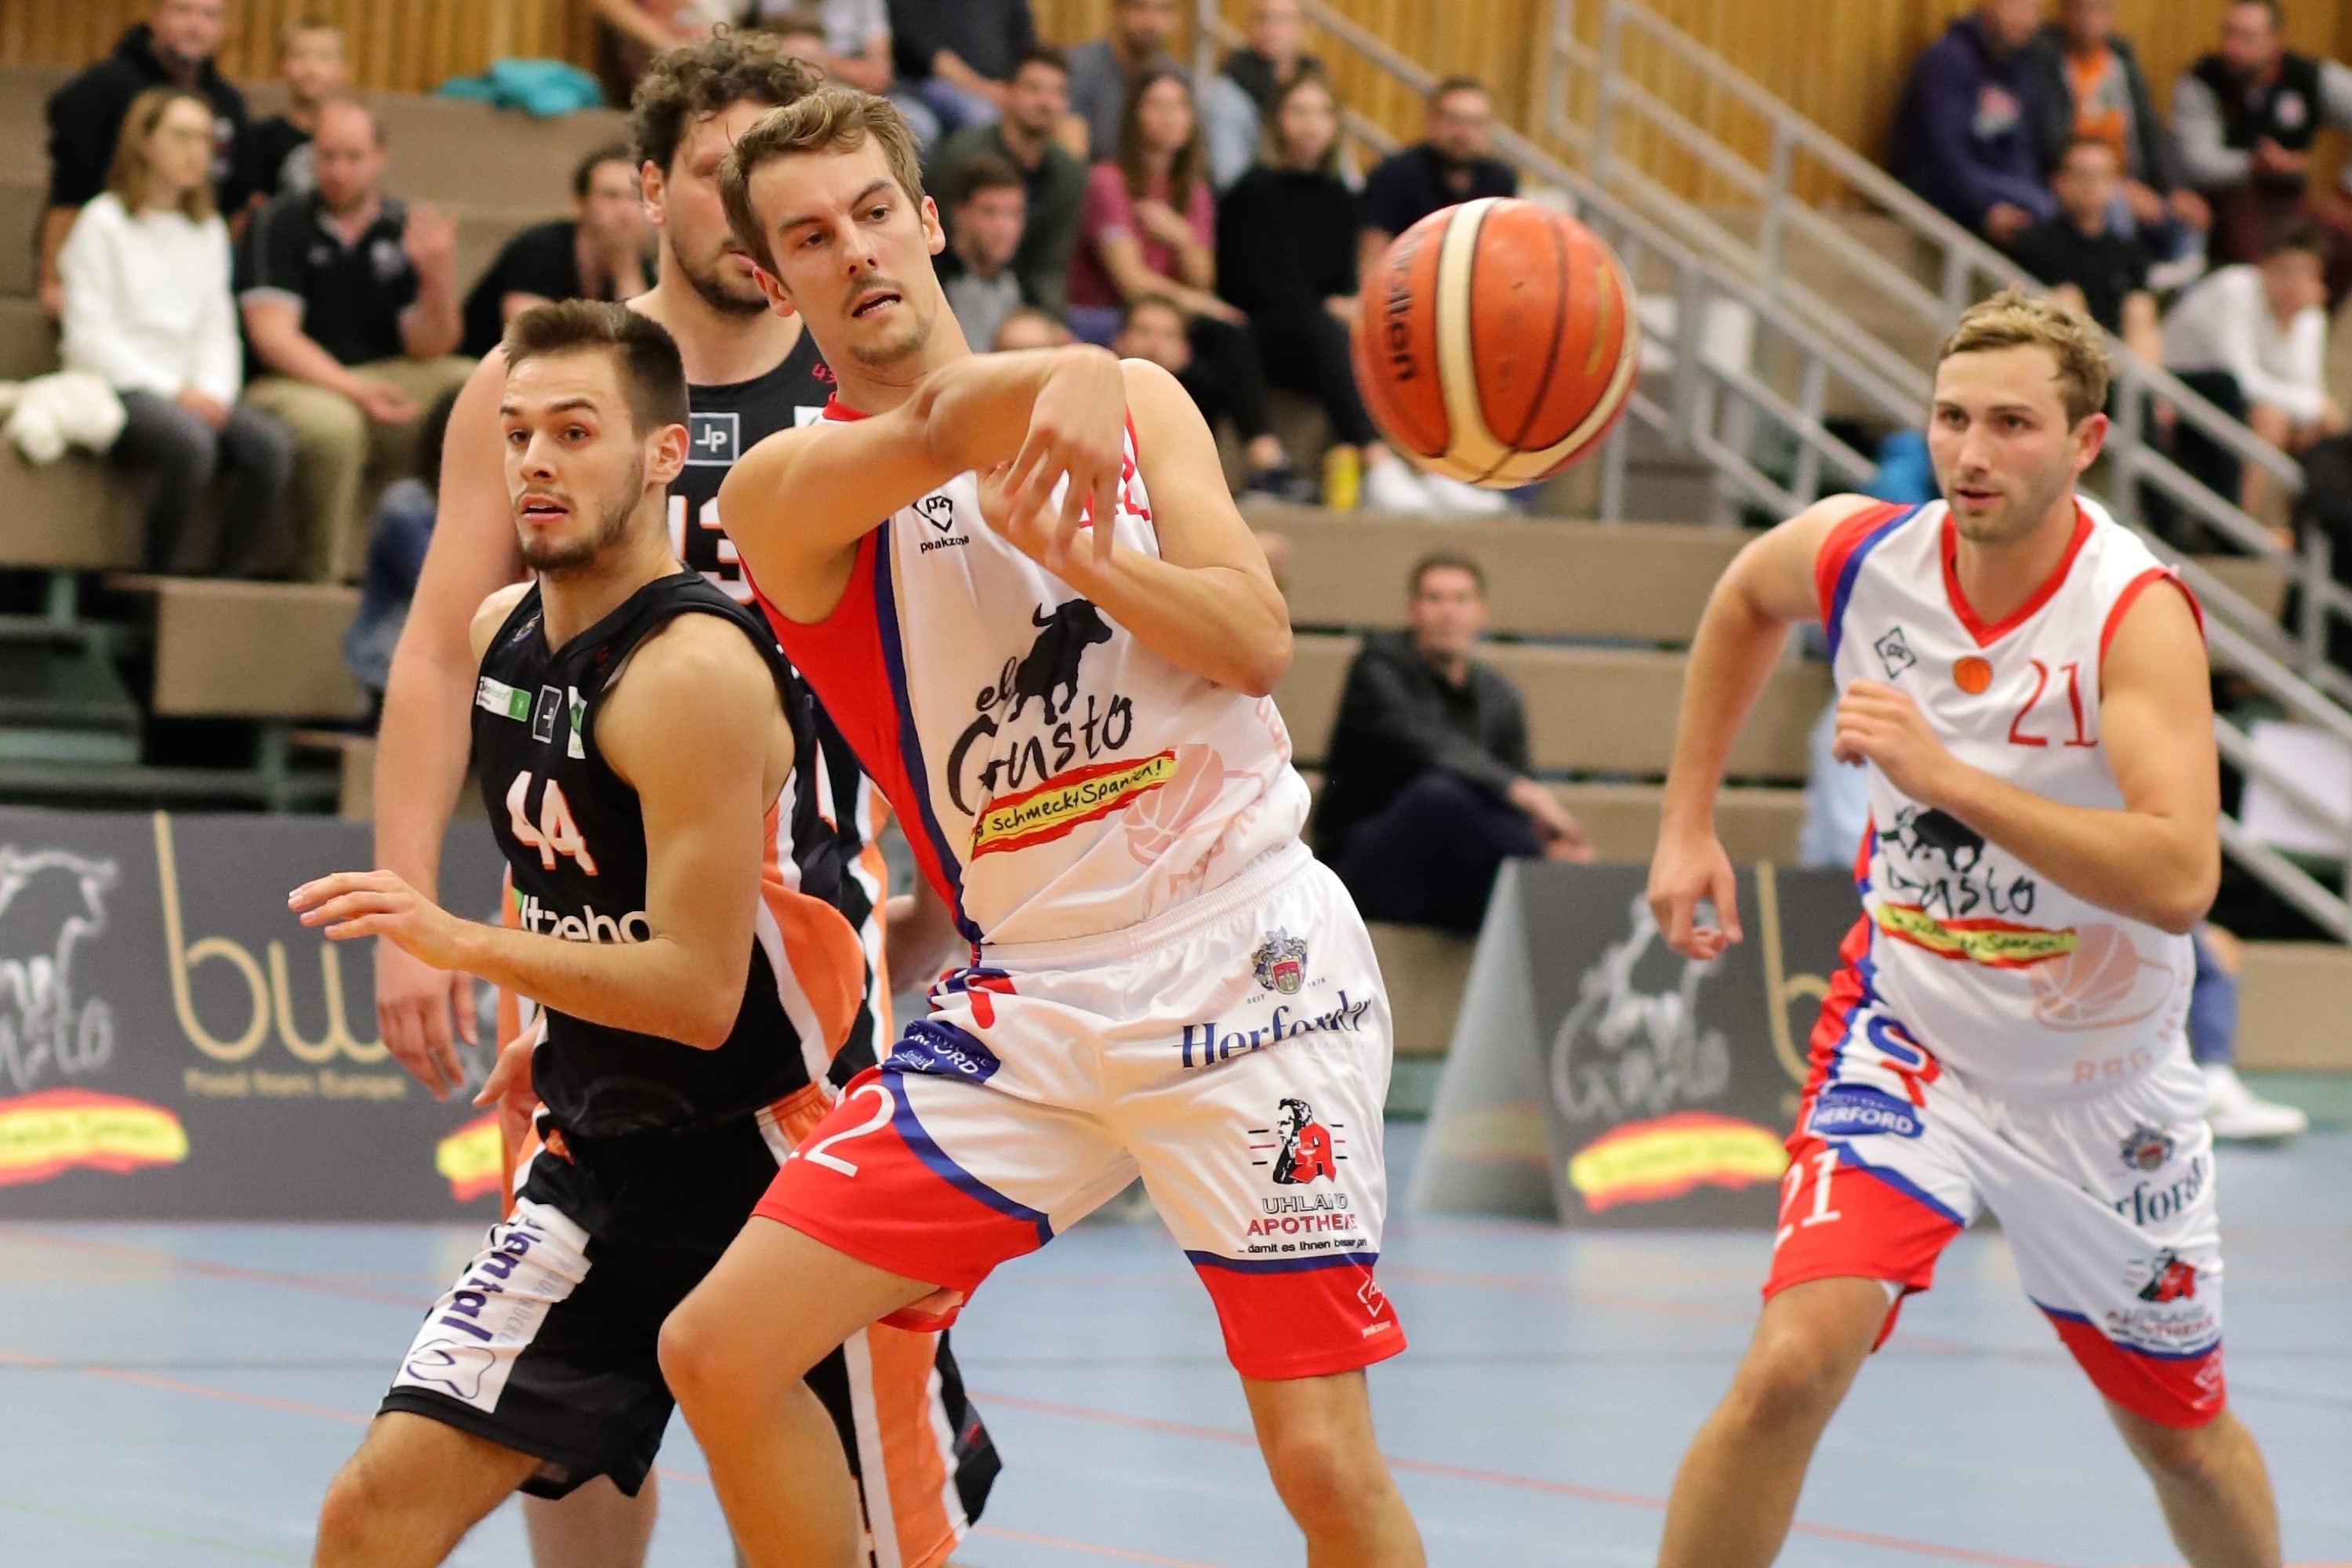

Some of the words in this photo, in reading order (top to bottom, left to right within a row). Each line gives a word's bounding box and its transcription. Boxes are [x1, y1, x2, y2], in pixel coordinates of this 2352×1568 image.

[695, 423, 728, 452] JP
[920, 535, 971, 554] peakzone
[976, 655, 1018, 712] el
[2008, 659, 2098, 747] 21
[947, 694, 1134, 818] Gusto
[506, 771, 598, 877] 44
[992, 789, 1080, 830] schmeckt
[1082, 759, 1163, 804] Spanien!
[788, 1083, 895, 1178] 2
[1262, 1193, 1348, 1214] UHLAND
[1248, 1243, 1278, 1254] damit
[1282, 1243, 1295, 1252] es
